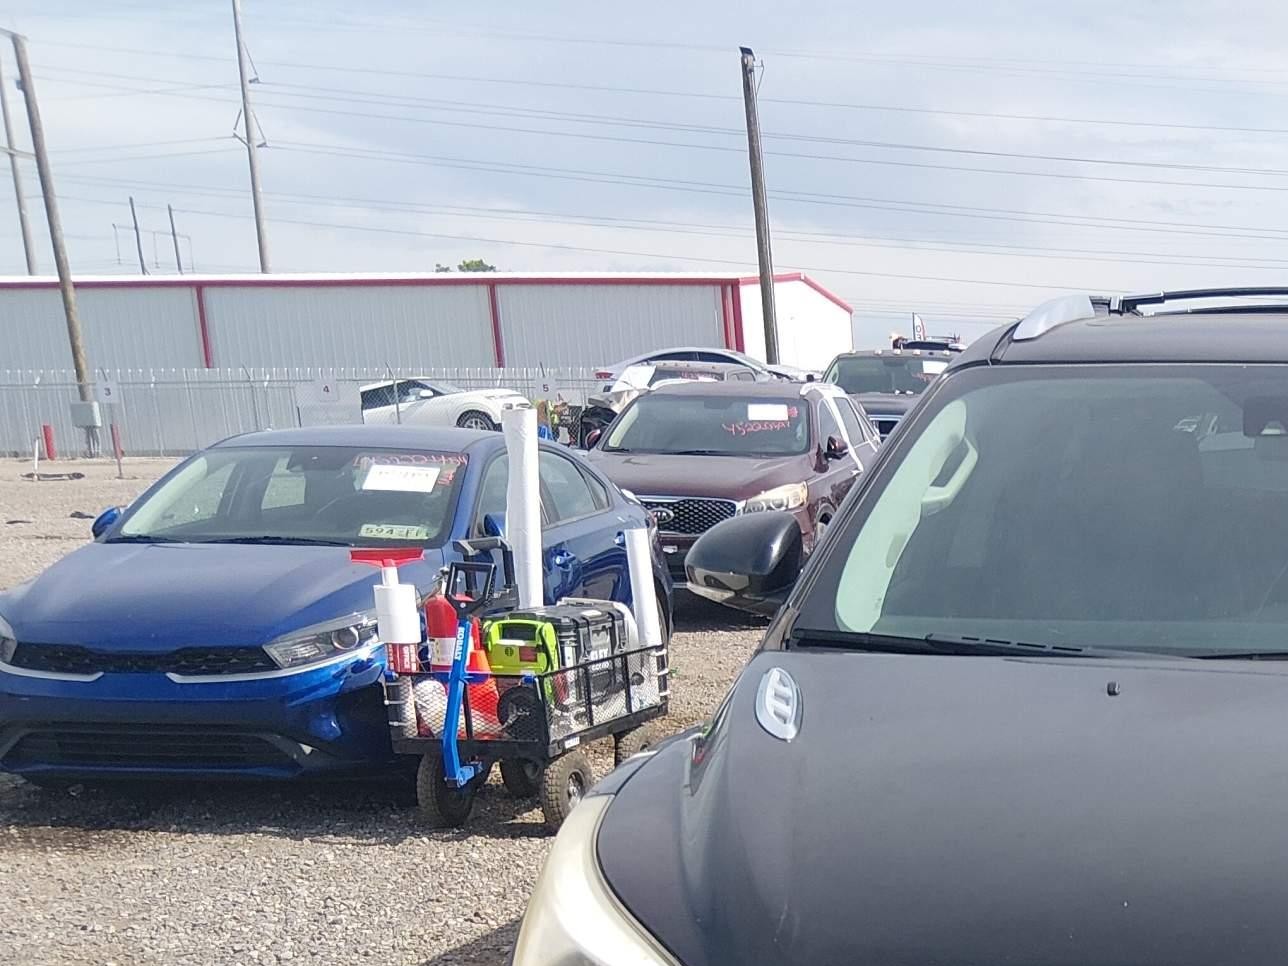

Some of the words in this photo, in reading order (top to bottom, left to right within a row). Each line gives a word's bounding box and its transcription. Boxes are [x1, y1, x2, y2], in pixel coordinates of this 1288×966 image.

[103, 387, 112, 396] 3
[542, 383, 549, 393] 5
[454, 626, 465, 661] KOBALT
